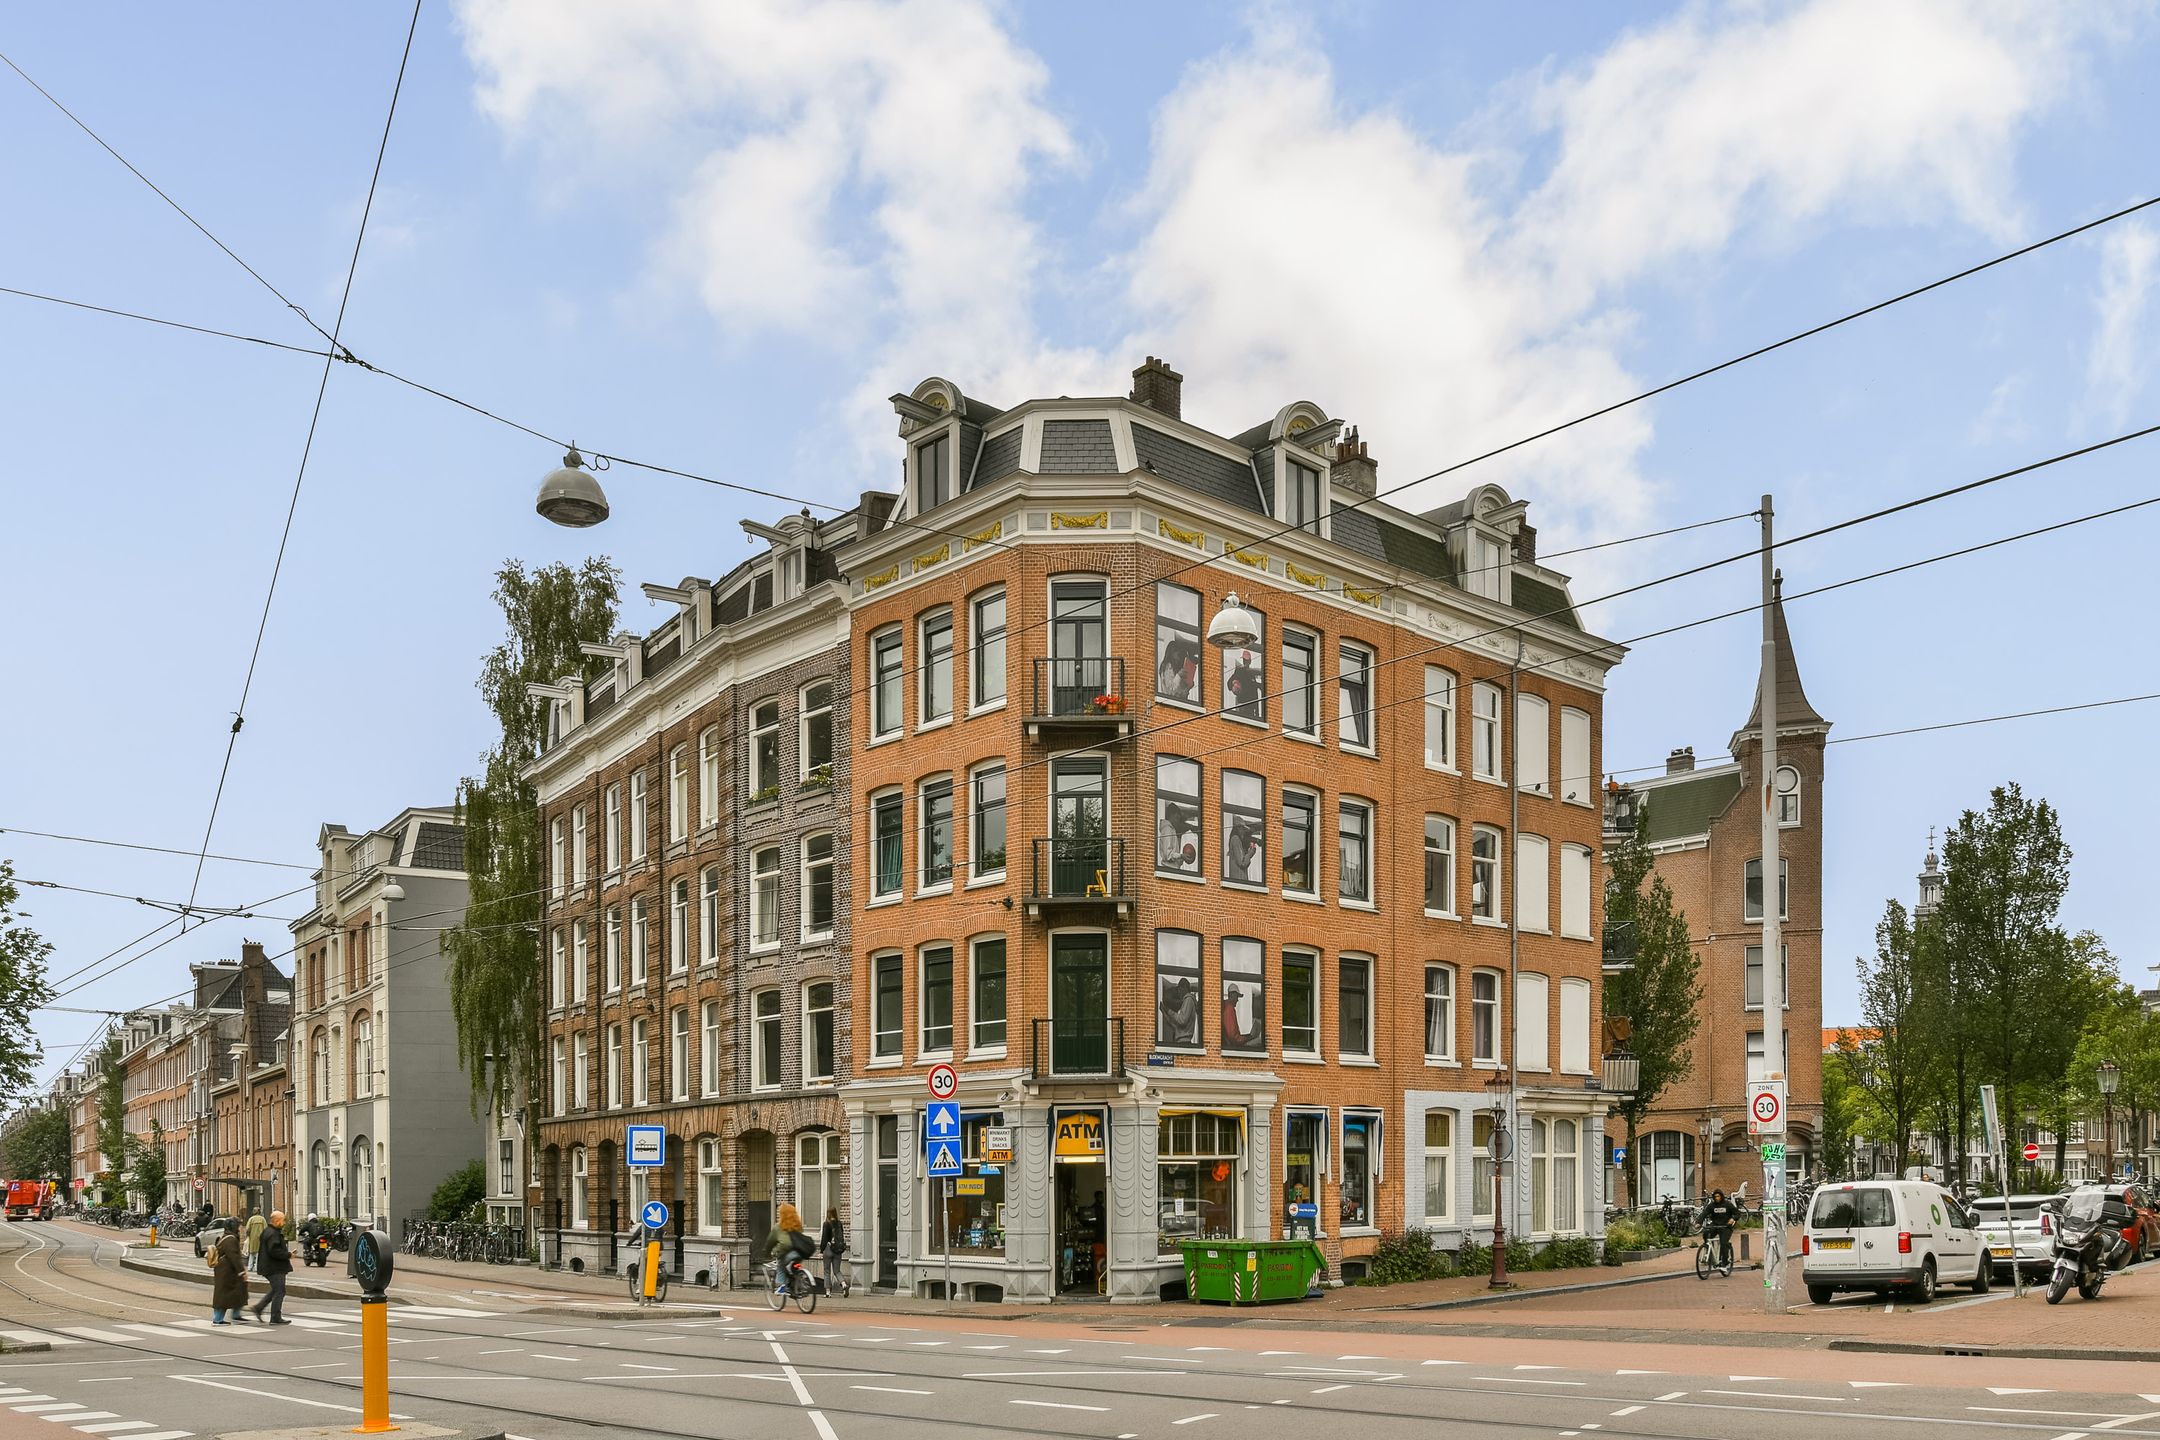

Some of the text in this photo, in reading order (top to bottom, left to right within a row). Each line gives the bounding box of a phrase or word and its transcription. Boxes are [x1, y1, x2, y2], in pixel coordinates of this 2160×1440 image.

[934, 1075, 953, 1089] 30
[1757, 1102, 1774, 1113] 30
[1058, 1123, 1102, 1139] ATM
[992, 1151, 1008, 1160] ATM
